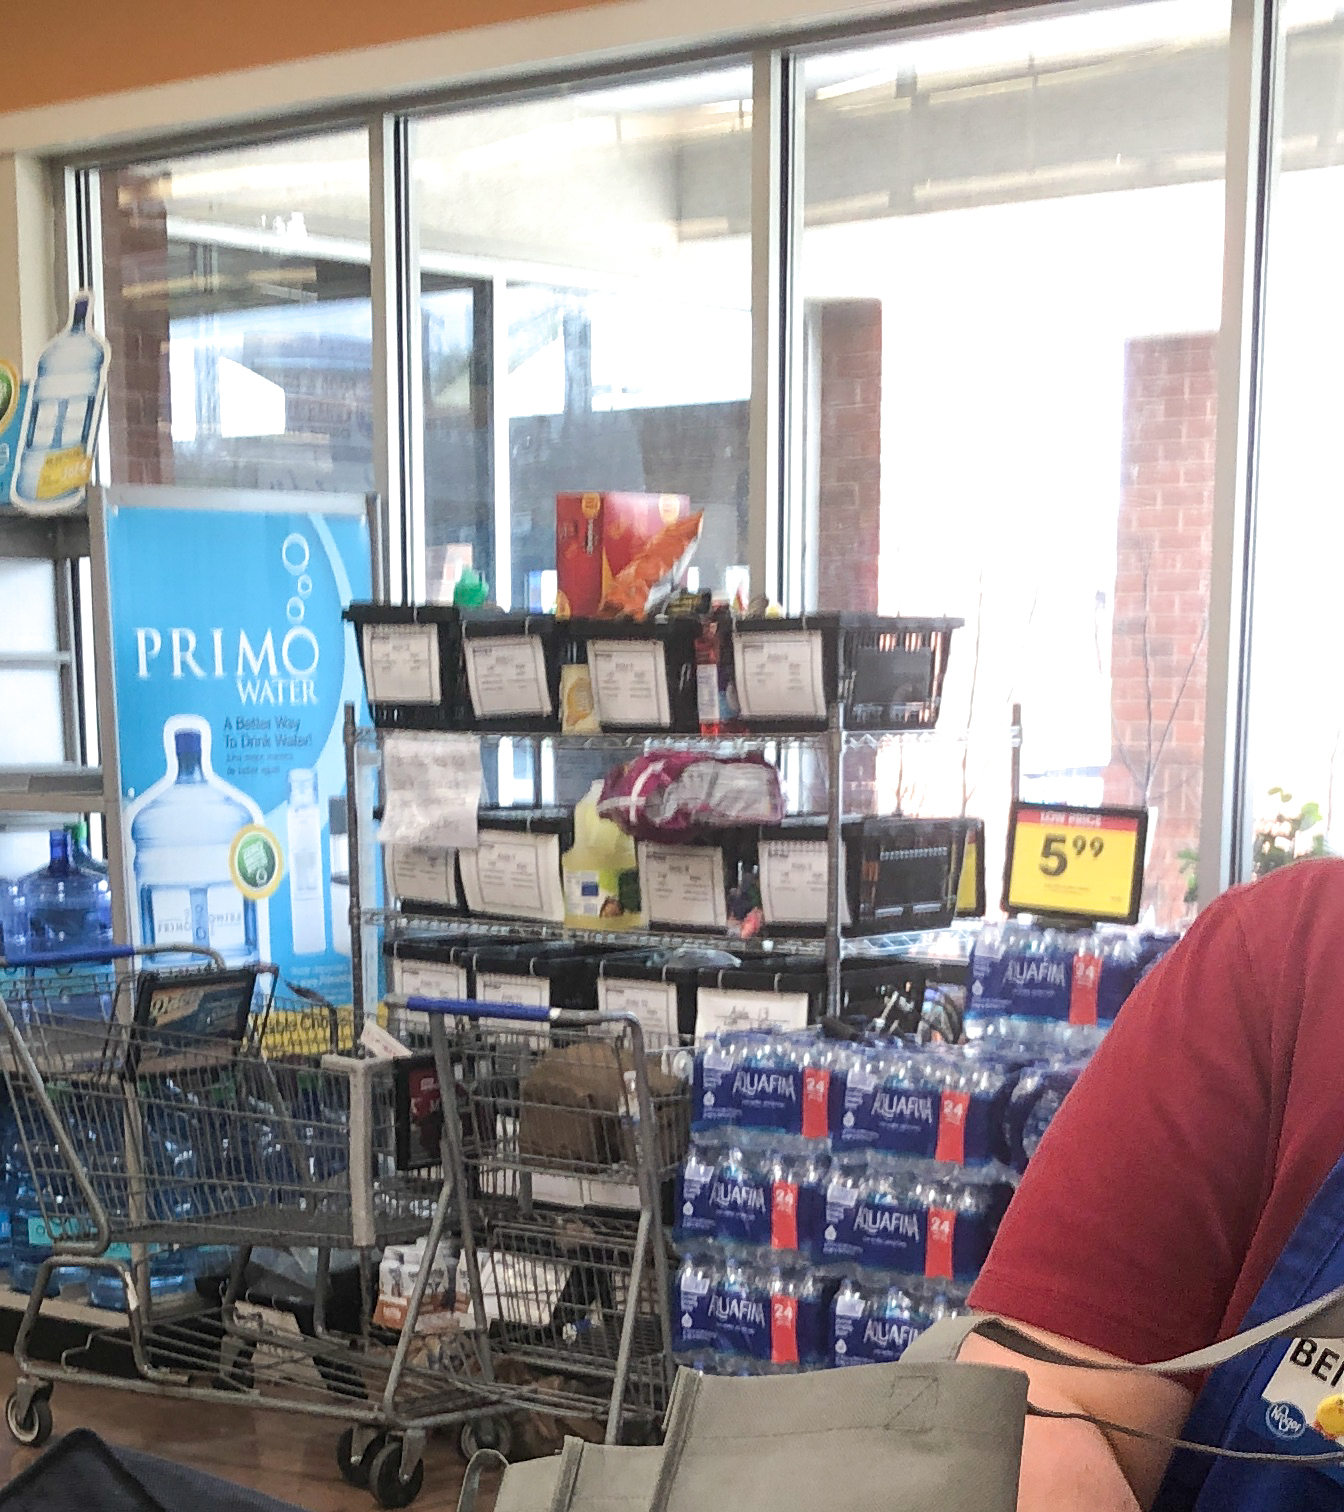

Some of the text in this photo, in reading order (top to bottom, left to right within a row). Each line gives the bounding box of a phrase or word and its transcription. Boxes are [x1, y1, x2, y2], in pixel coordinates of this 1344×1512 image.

[134, 625, 320, 680] PRIMO
[236, 678, 319, 706] WATER
[236, 716, 271, 731] Better
[274, 716, 301, 733] Way
[241, 734, 272, 748] Drink
[806, 1077, 826, 1093] 24
[943, 1100, 964, 1115] 24
[775, 1189, 795, 1204] 24
[930, 1217, 950, 1234] 24
[774, 1306, 794, 1320] 24
[863, 1319, 922, 1348] AQUAFI
[1268, 1403, 1304, 1434] Kroger
